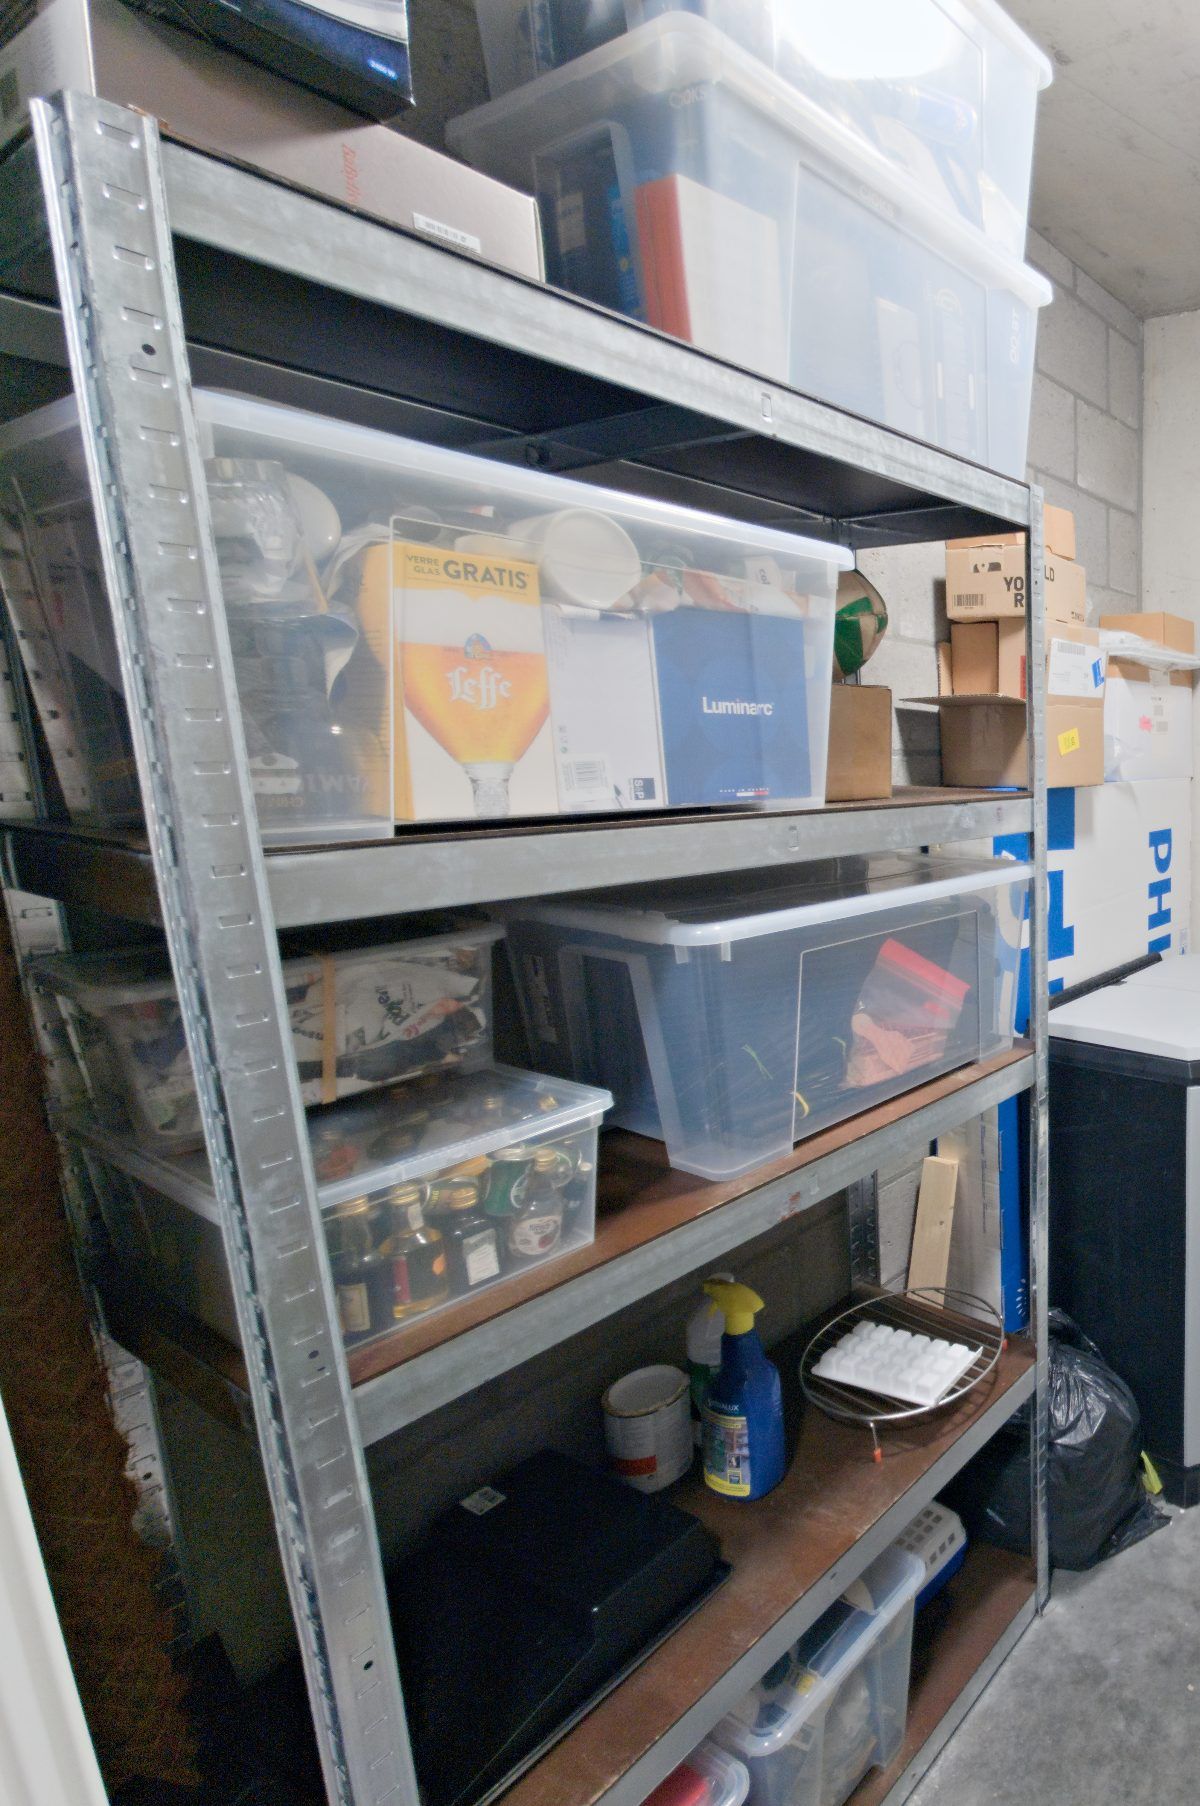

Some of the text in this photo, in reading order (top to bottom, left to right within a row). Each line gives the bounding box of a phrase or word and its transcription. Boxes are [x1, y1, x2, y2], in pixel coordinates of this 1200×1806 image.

[406, 554, 440, 567] VERRE
[413, 565, 441, 576] GLAS
[443, 559, 528, 589] GRATIS
[444, 666, 513, 711] Leffe
[702, 696, 773, 716] Luminarc
